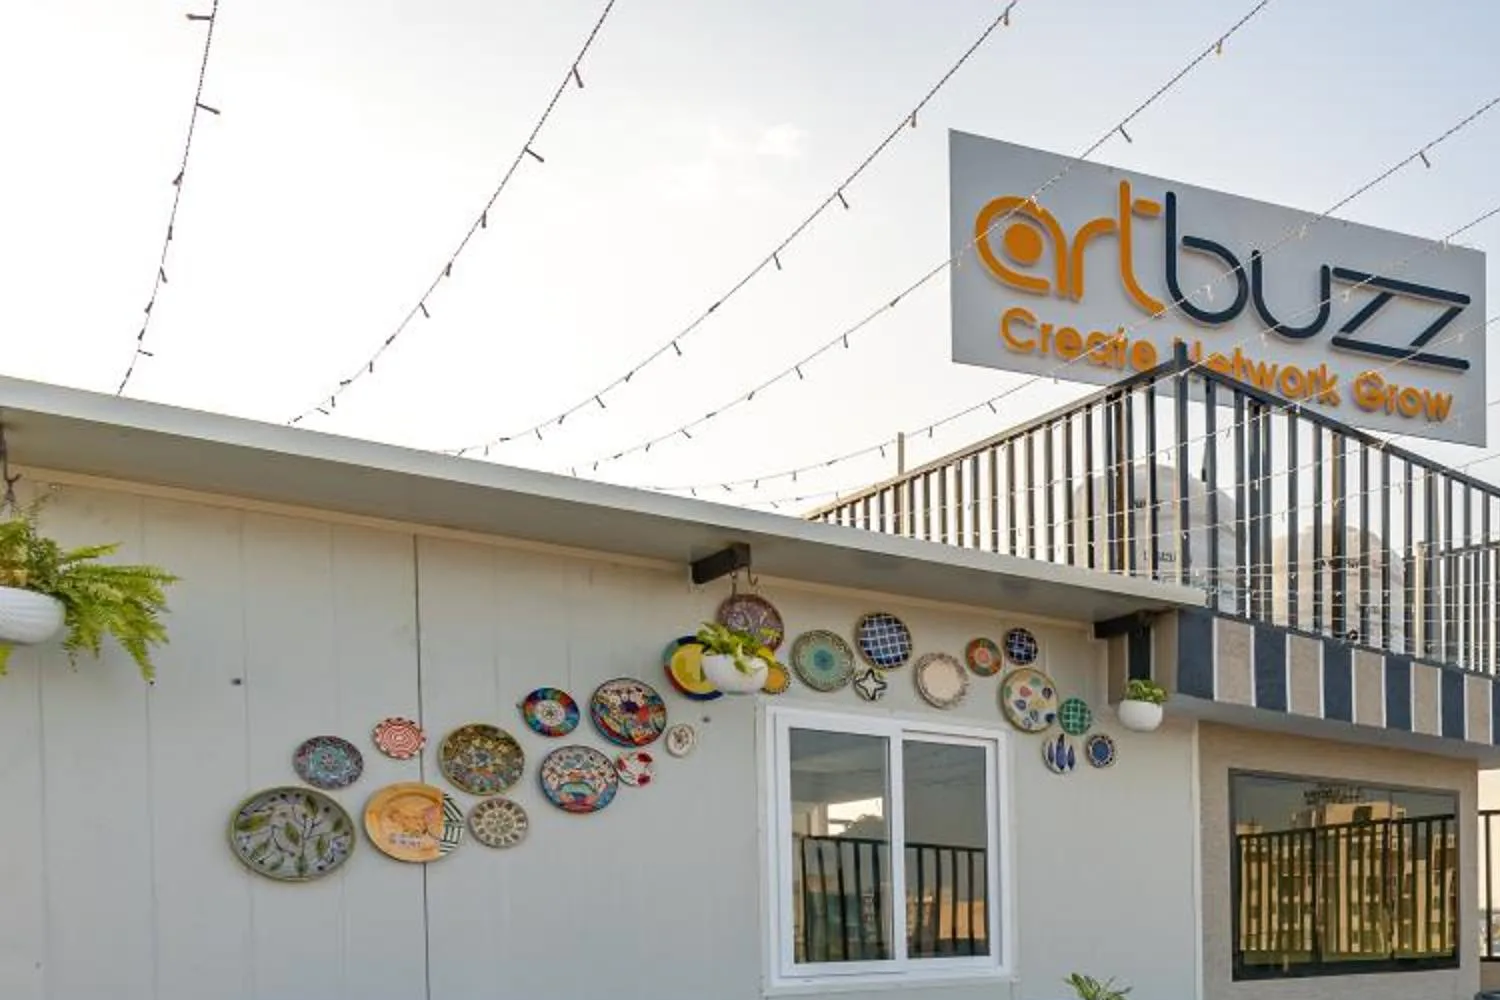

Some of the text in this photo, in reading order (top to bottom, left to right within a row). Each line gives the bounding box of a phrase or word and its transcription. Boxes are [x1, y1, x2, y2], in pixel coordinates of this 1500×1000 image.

[1000, 306, 1454, 423] Create etwork Grow
